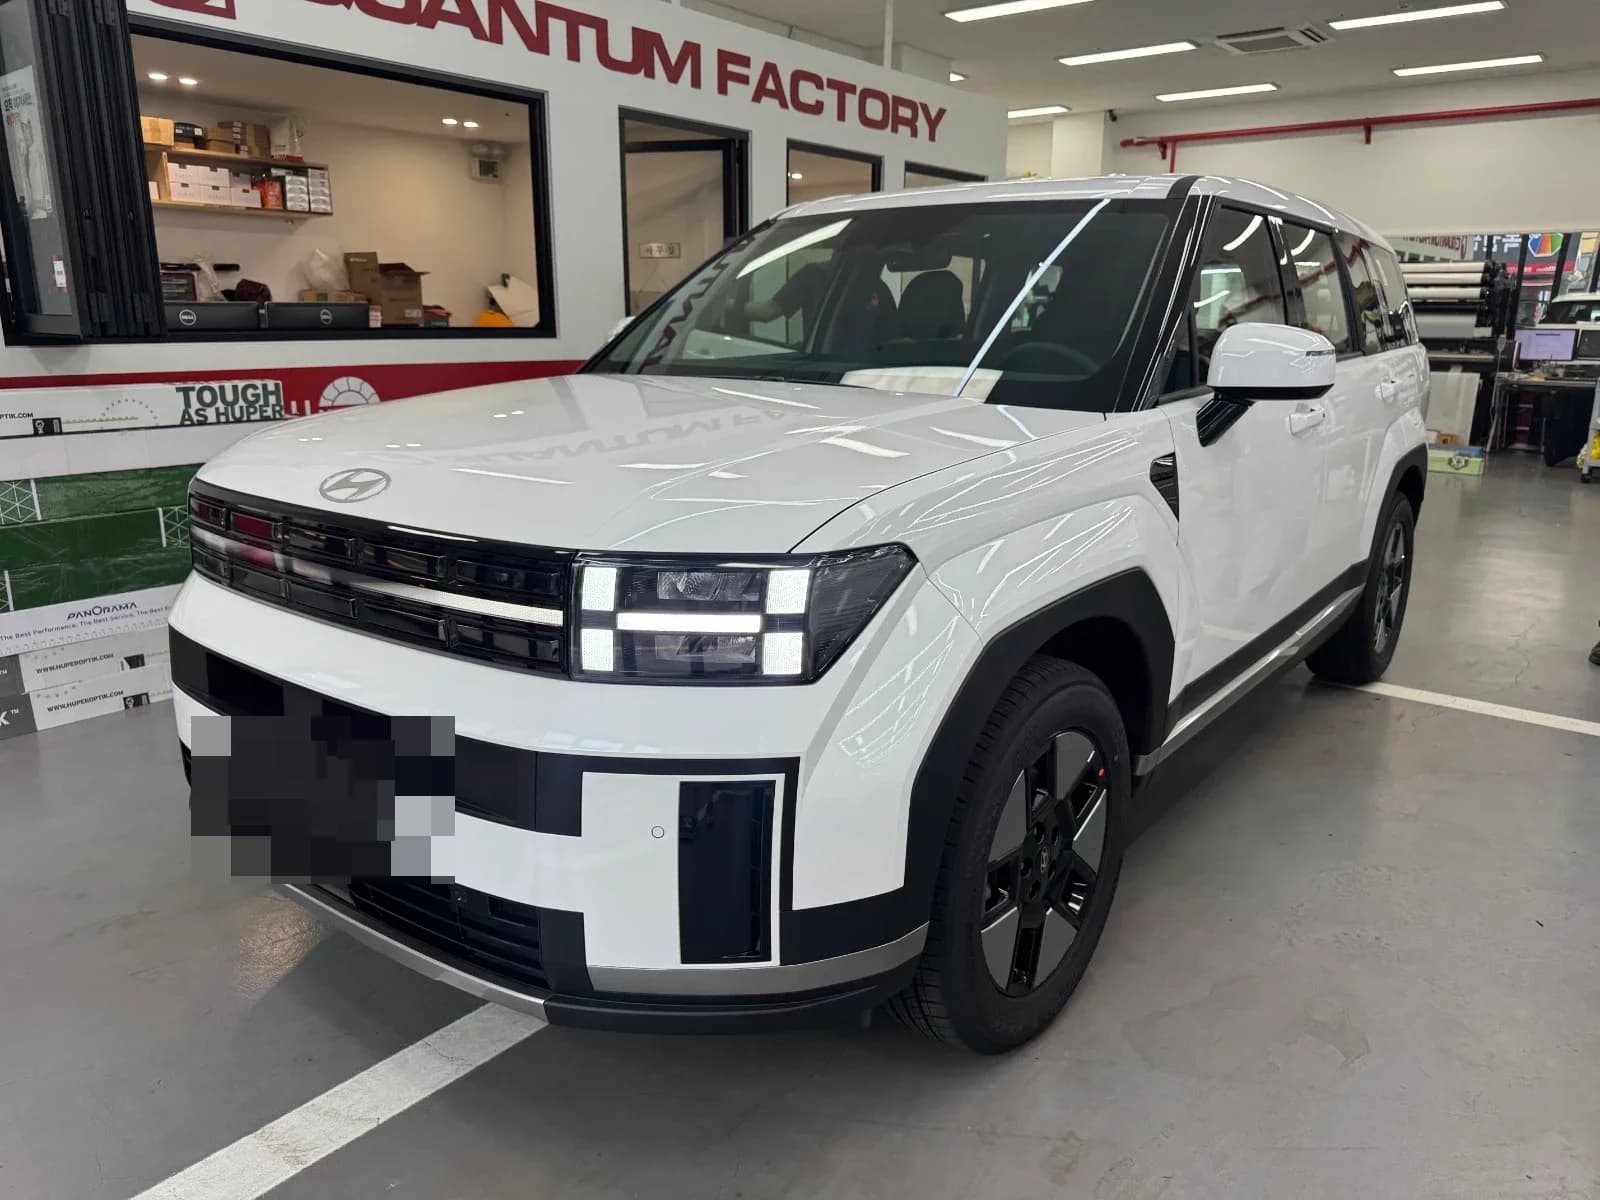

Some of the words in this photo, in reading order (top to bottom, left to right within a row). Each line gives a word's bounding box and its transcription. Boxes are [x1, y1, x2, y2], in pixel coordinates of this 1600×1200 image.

[302, 0, 702, 89] ANTUM
[717, 48, 947, 142] FACTORY
[175, 382, 281, 409] TOUGH
[179, 407, 208, 425] AS
[215, 403, 284, 424] HUPER
[67, 602, 137, 620] PANORAMA
[93, 617, 108, 625] Best
[36, 653, 114, 674] WWW.HUPEROPTIK.COM
[47, 690, 124, 712] WWW.HUPEROPTIK.COM
